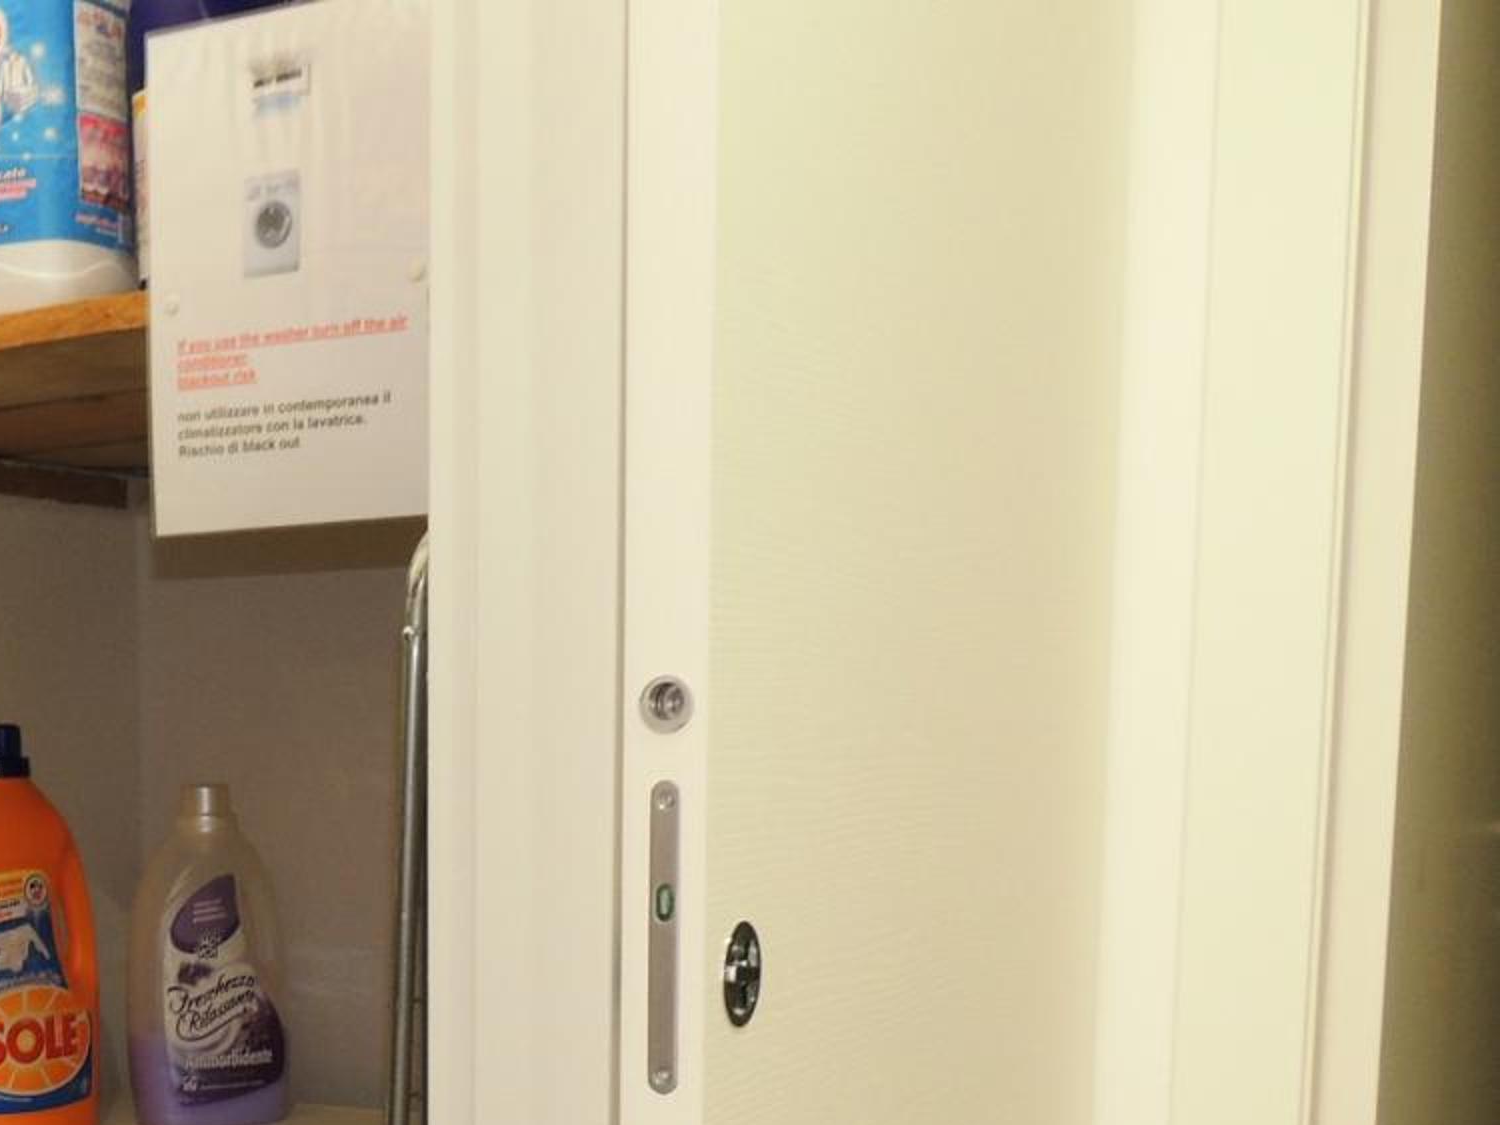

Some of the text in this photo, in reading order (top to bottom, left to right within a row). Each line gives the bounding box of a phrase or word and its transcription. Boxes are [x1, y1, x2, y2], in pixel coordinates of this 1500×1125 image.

[240, 334, 260, 347] the
[262, 326, 310, 345] washer
[363, 318, 387, 334] the
[178, 387, 392, 422] non utilizzare in contemporanea il
[265, 421, 290, 433] con
[293, 416, 305, 430] la
[178, 436, 301, 457] Rischio di black out
